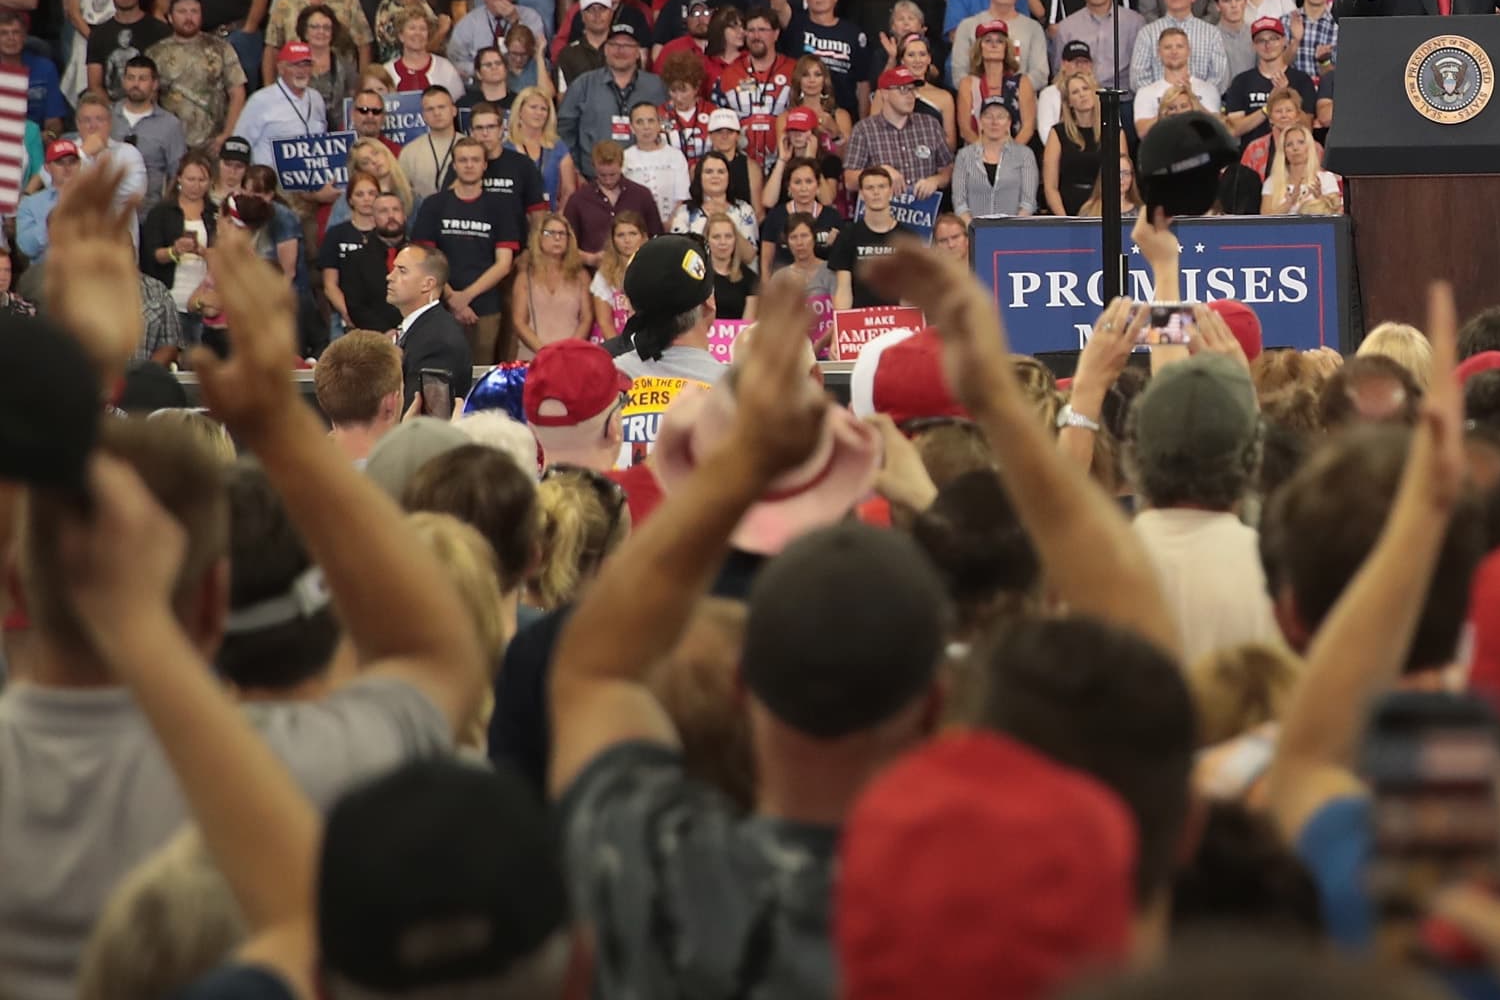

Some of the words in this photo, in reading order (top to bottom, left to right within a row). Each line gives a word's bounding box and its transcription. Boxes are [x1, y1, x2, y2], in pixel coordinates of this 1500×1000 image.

[804, 31, 851, 54] Trump
[1408, 38, 1447, 79] PRESIDENT
[1471, 47, 1493, 85] UNITED
[384, 100, 400, 111] EP
[1420, 101, 1443, 119] SEAL
[1458, 91, 1488, 119] STATES
[384, 113, 425, 130] RICA
[282, 138, 347, 160] DRAIN
[304, 157, 329, 169] THE
[484, 178, 514, 187] UMP
[893, 193, 915, 205] EP
[442, 219, 491, 231] TRUMP
[857, 246, 893, 256] TRUM
[865, 316, 896, 326] MAKE
[840, 326, 921, 343] AMER
[709, 344, 731, 355] FO
[841, 343, 863, 354] PRO
[641, 378, 652, 389] ON
[656, 378, 674, 388] THE
[628, 391, 671, 407] KERS
